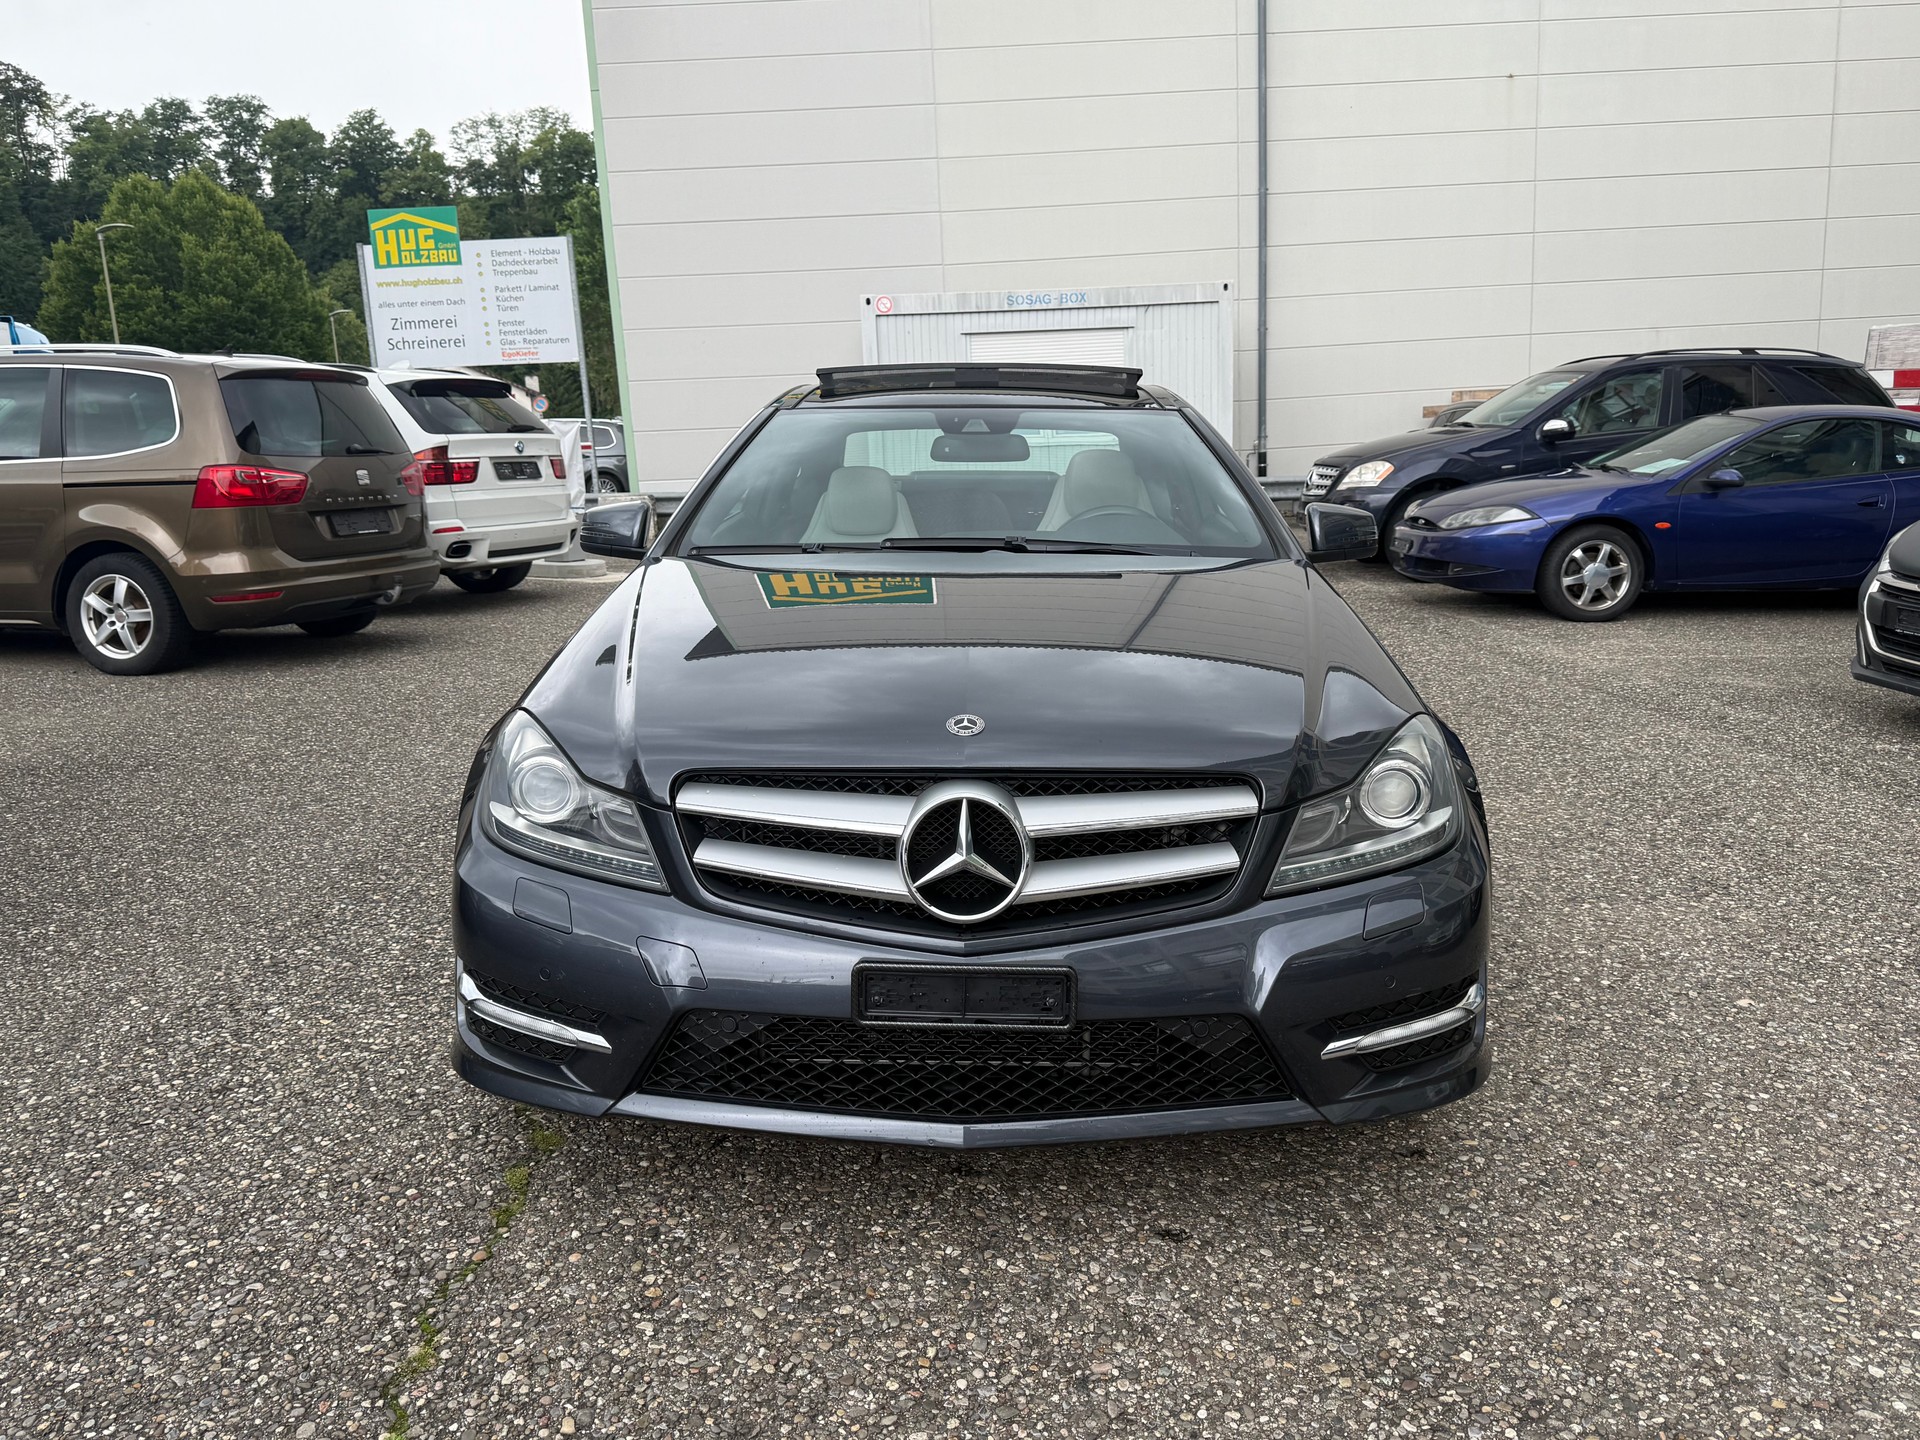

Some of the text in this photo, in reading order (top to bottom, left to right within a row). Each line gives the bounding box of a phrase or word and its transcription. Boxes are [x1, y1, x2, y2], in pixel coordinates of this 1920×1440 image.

[375, 228, 435, 265] HUG
[490, 249, 522, 258] Element
[528, 247, 561, 256] Holzbau
[491, 257, 559, 267] Dachdeckerarbeit
[493, 268, 538, 277] Treppenbau
[376, 277, 463, 288] www.hugholzbau.ch
[494, 285, 522, 293] Parkett
[528, 284, 560, 292] Laminat
[378, 298, 466, 309] alles unter einem Dach
[496, 295, 524, 303] Küchen
[1006, 292, 1087, 306] SOSAG-BOX
[497, 304, 519, 312] Türen
[390, 315, 458, 331] Zimmerei
[498, 319, 525, 327] Fenster
[499, 328, 548, 337] Fensterläden
[387, 334, 466, 351] Schreinerei
[500, 338, 517, 346] Glas
[522, 336, 570, 345] Reparaturen
[501, 350, 539, 358] EgoKiefer
